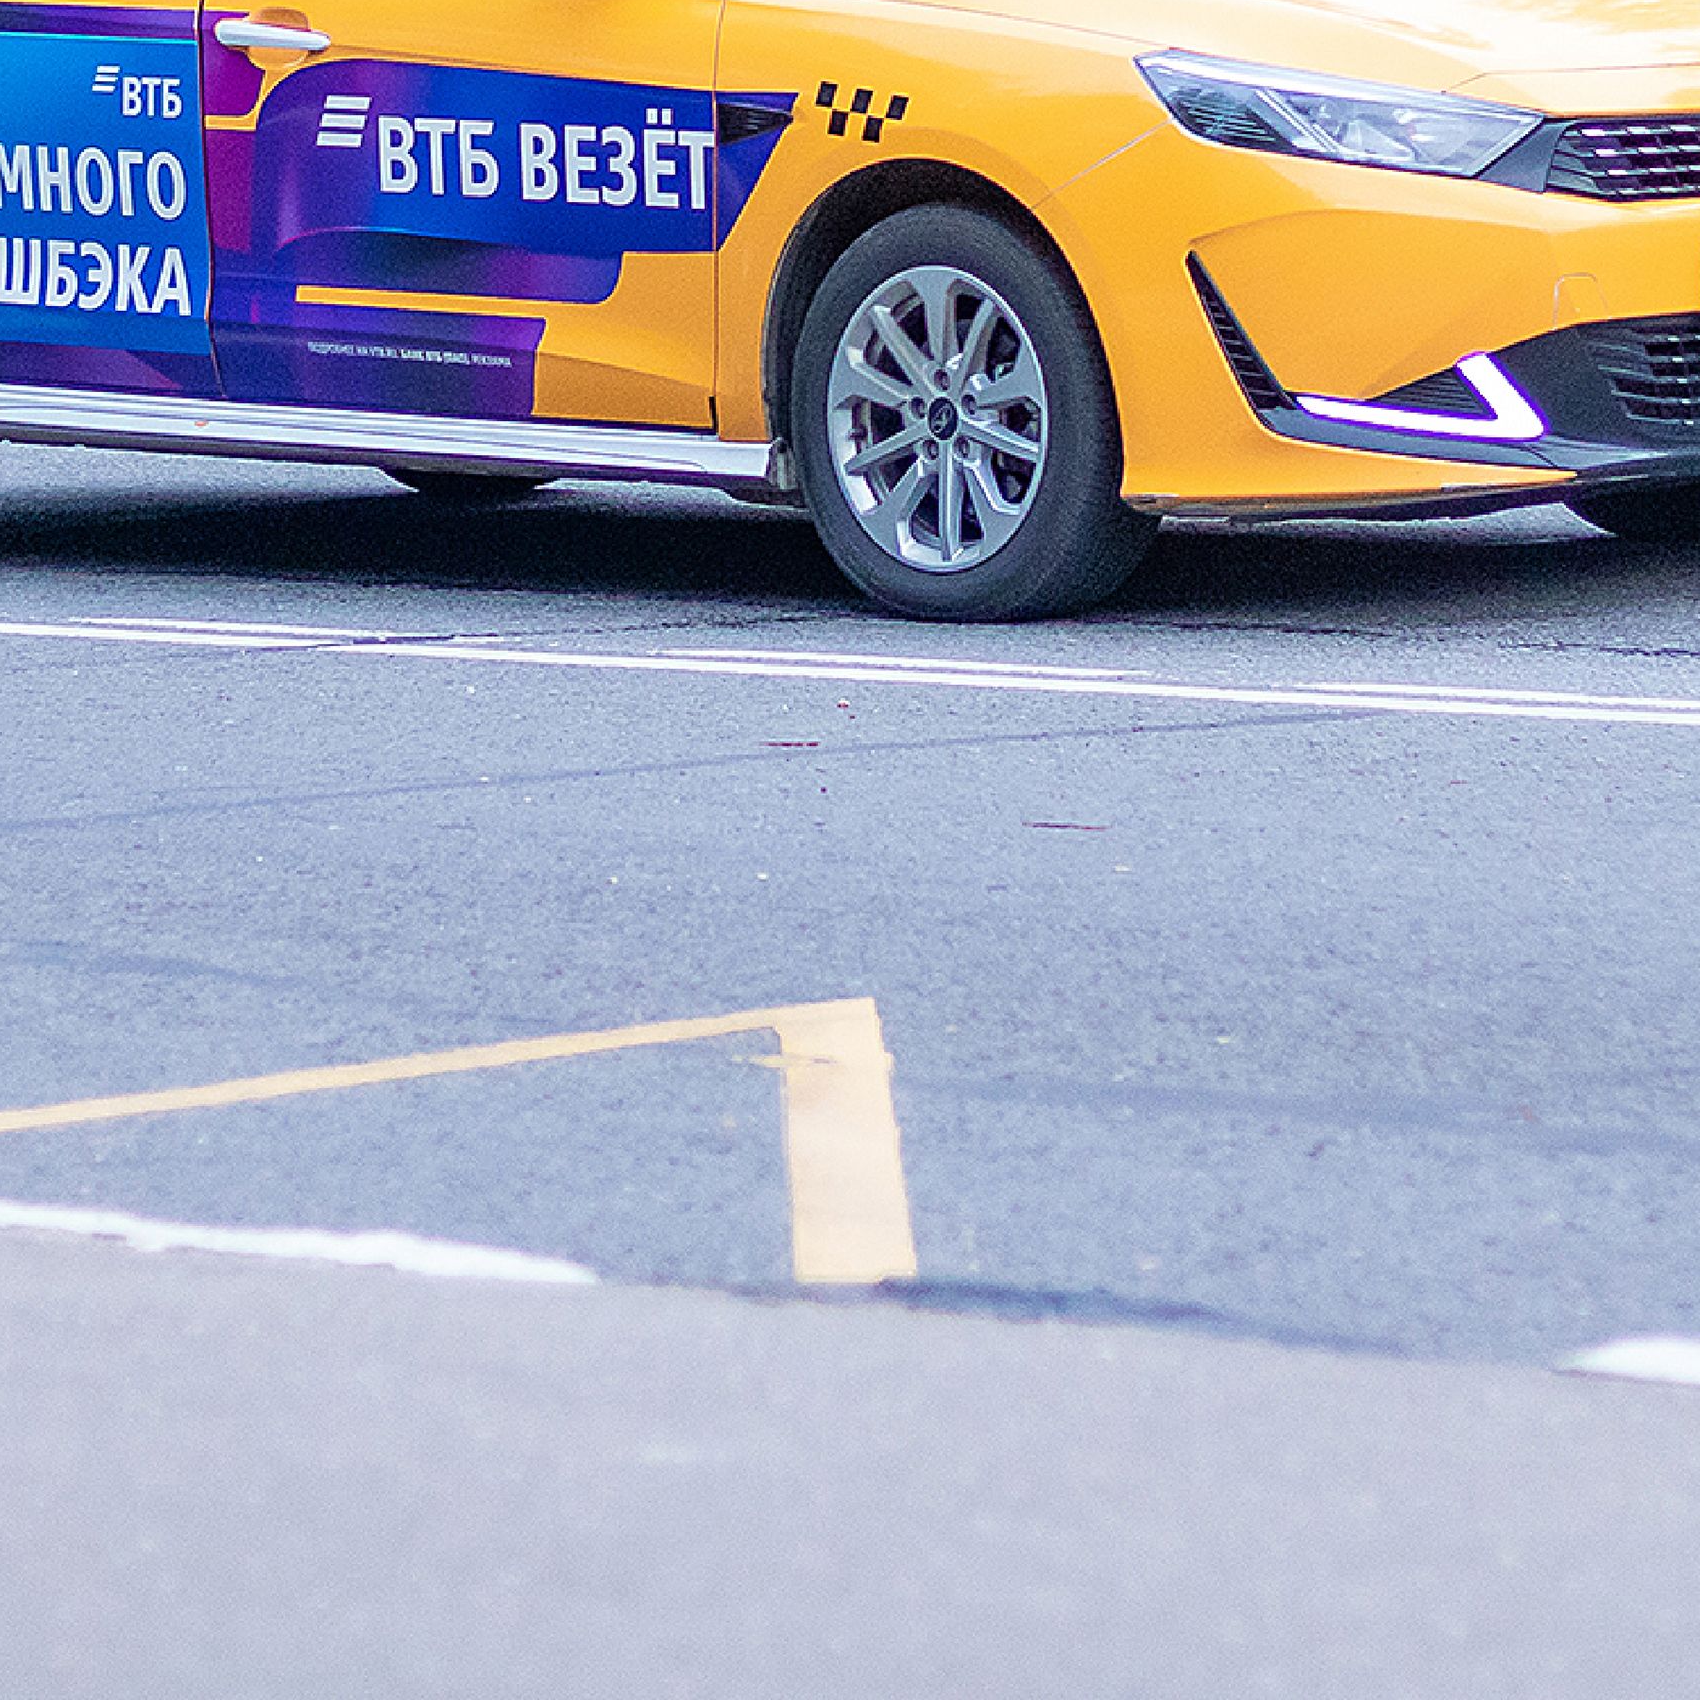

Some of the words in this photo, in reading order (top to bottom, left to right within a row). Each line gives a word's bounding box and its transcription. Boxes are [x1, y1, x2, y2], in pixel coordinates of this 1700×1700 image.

[122, 76, 182, 118] ВТБ
[377, 115, 499, 197] ВТБ
[519, 108, 714, 210] ВЕЗЁТ
